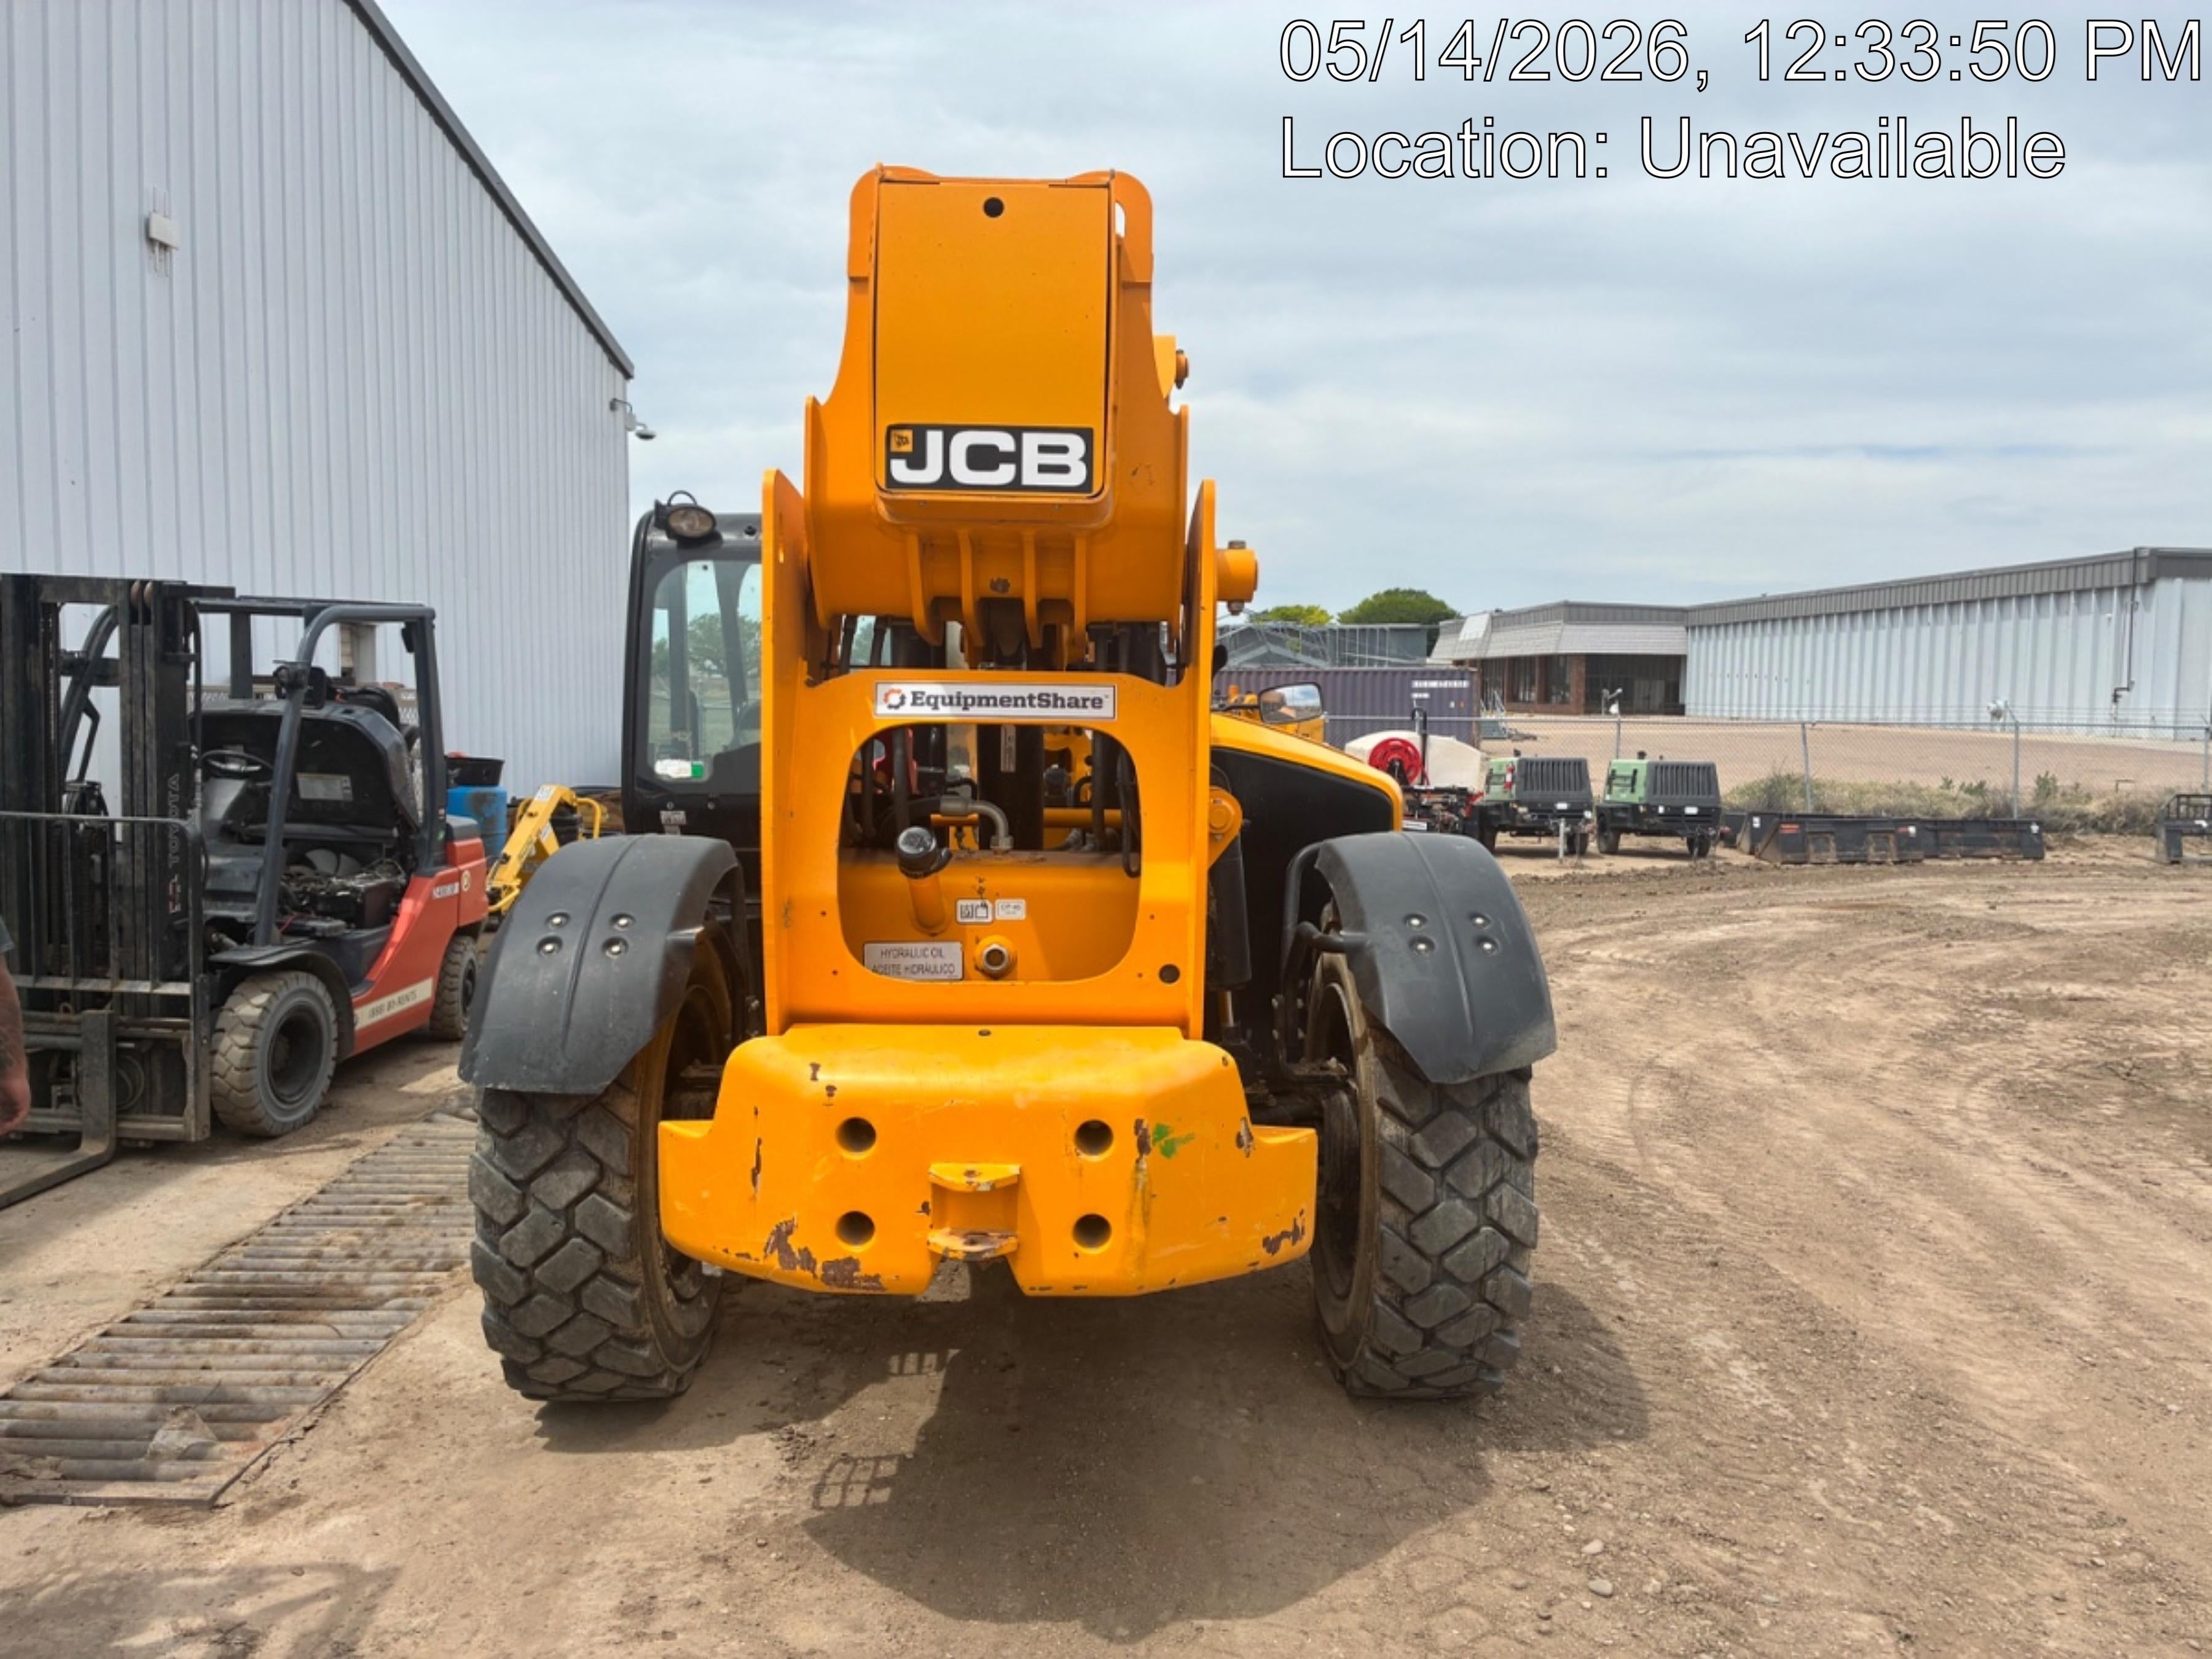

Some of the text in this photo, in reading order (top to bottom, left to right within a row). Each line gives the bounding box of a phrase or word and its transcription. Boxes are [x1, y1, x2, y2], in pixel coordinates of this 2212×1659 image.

[890, 429, 1087, 487] JCB
[910, 690, 1104, 711] EquipmentShare
[880, 947, 929, 959] HYDRAULIC
